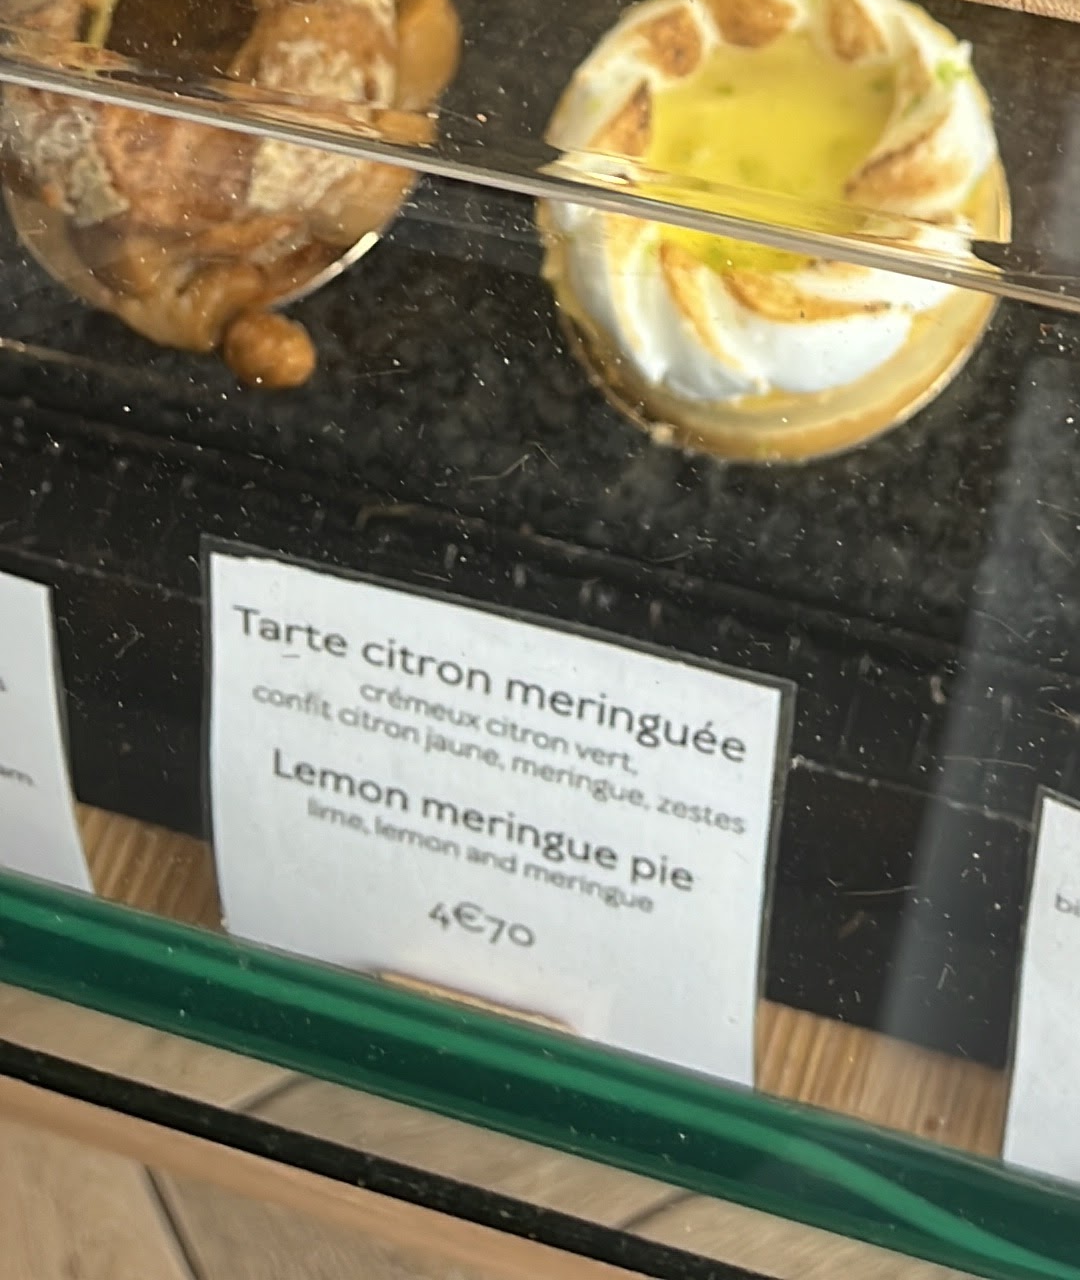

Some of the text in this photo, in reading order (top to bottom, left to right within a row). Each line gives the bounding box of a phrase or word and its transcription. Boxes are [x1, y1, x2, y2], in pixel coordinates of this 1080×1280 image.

[232, 604, 746, 763] Tarte citron meringuée
[360, 683, 638, 776] crémeux citron vert,
[252, 685, 746, 835] confit citron jaune, meringue, zestes
[273, 747, 694, 892] Lemon meringue pie
[307, 797, 654, 914] lime, lemon and meringue
[429, 901, 536, 948] 4€70
